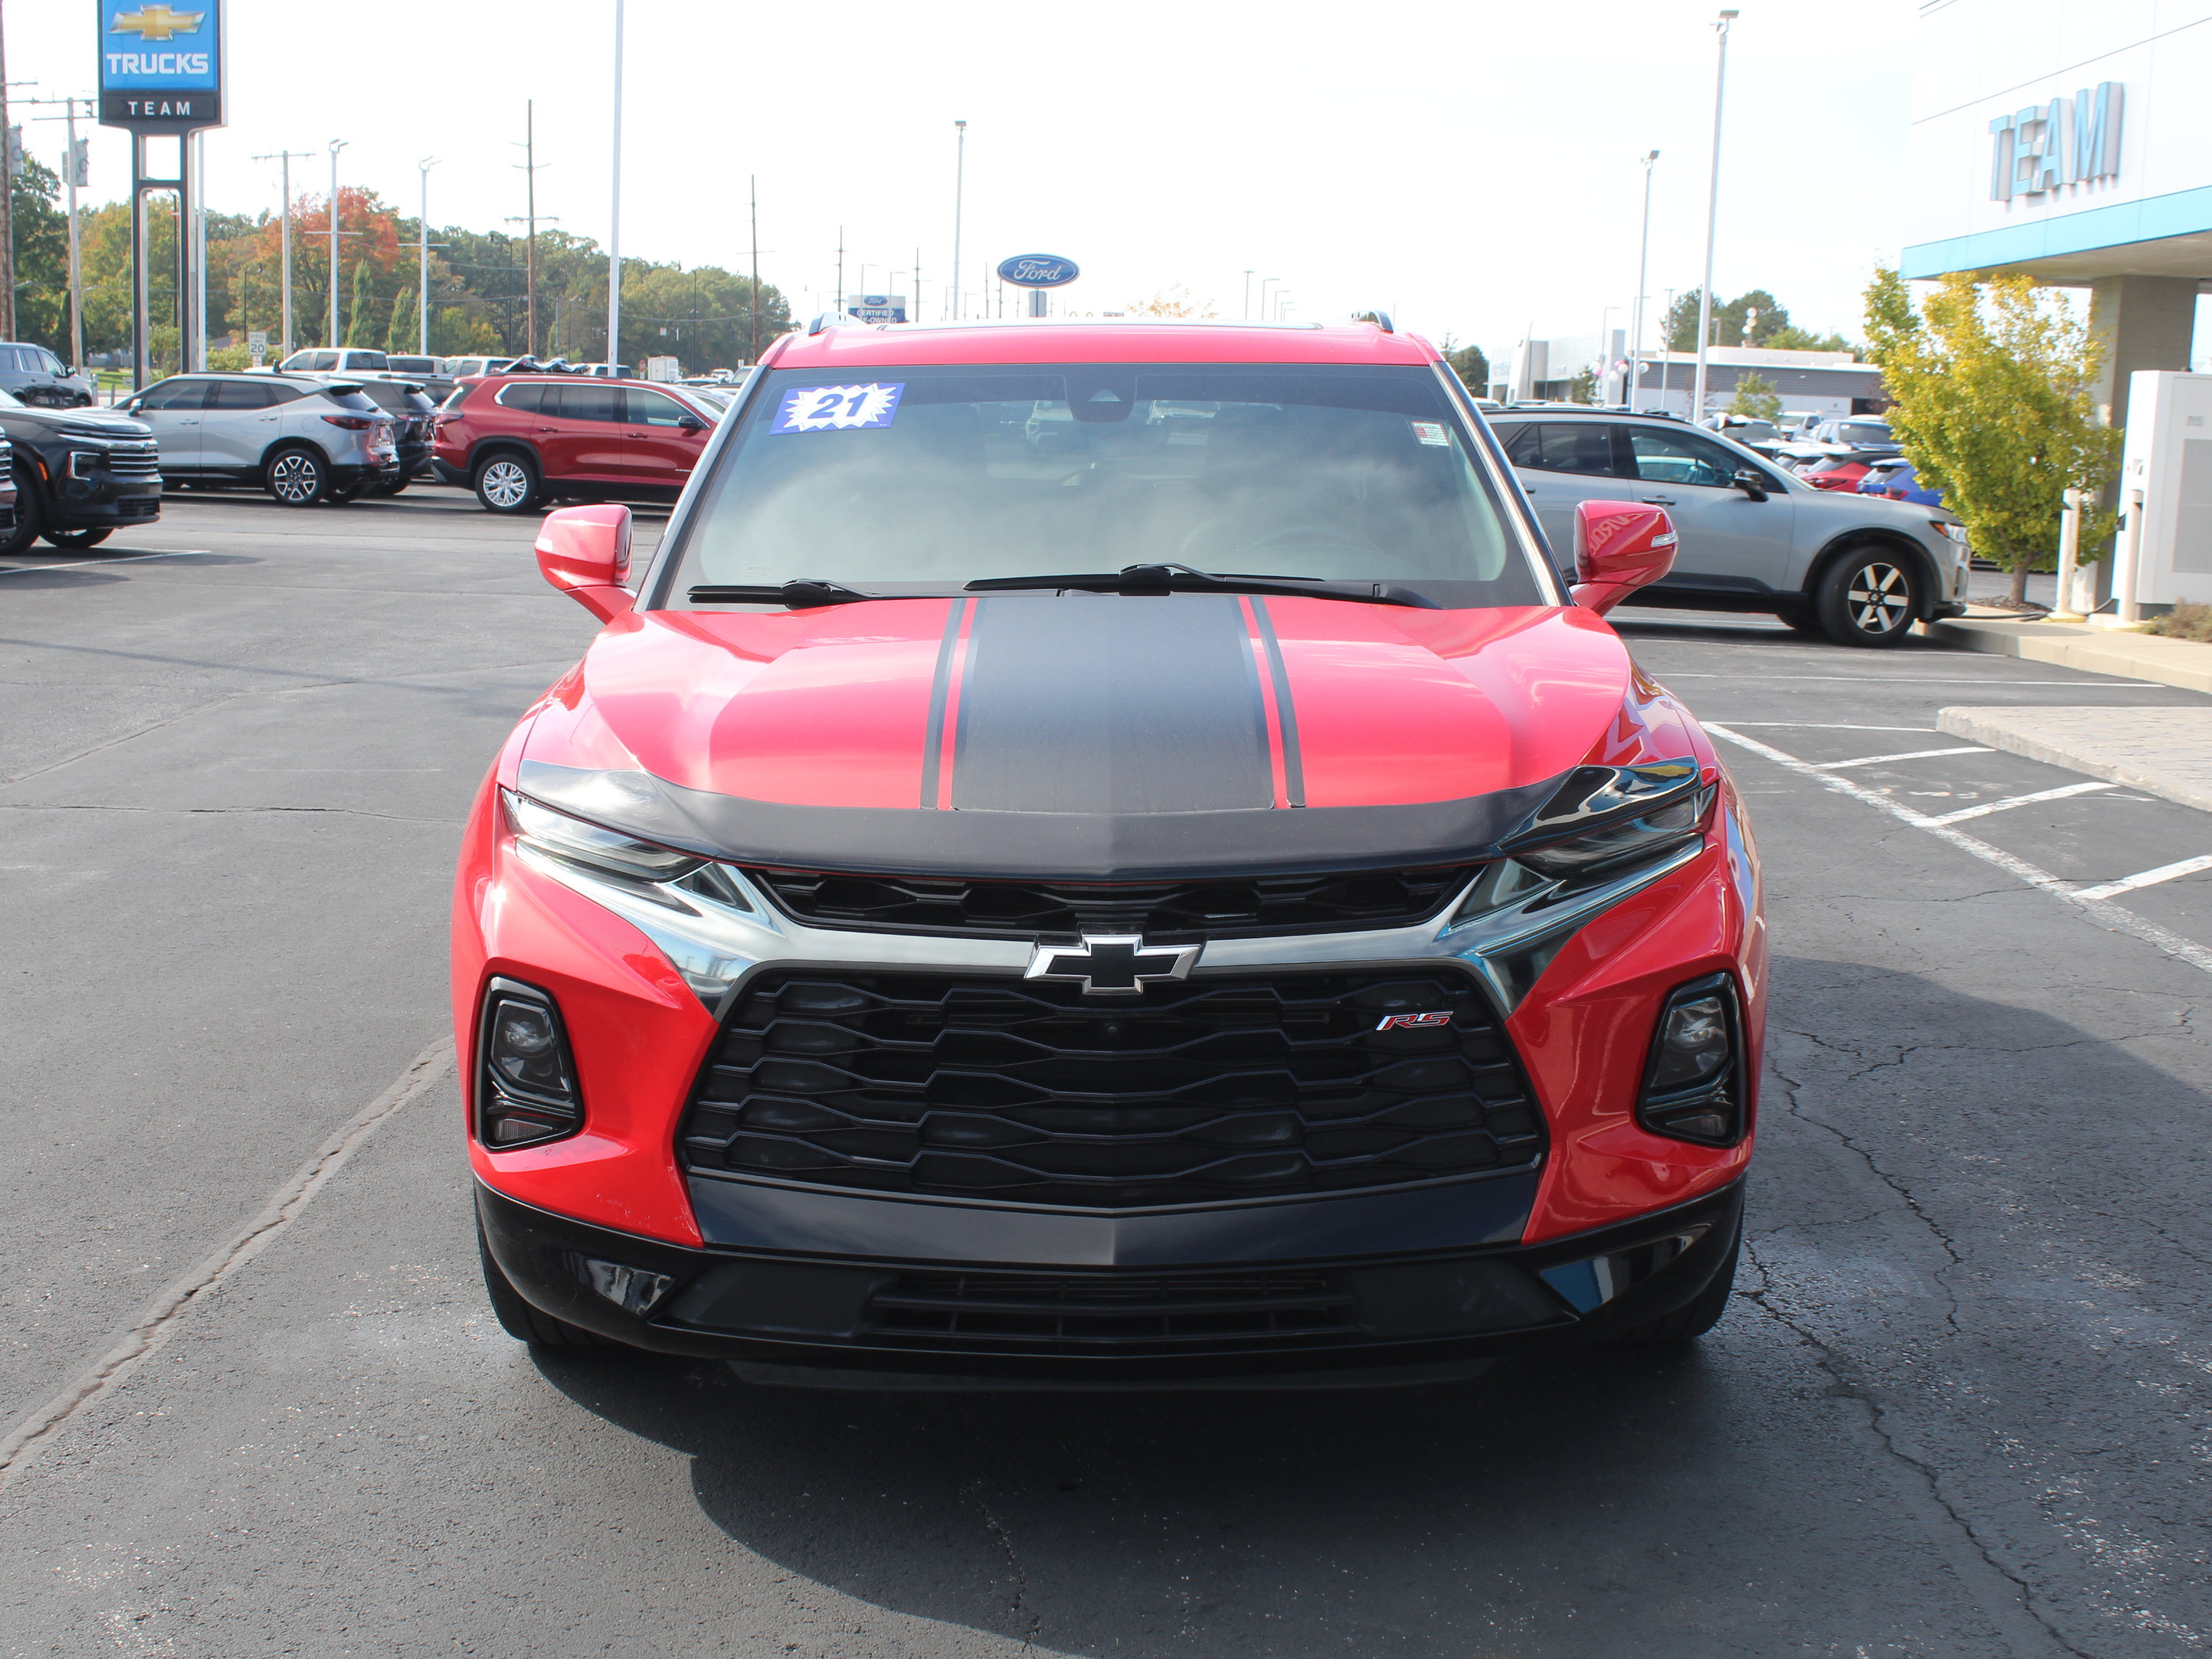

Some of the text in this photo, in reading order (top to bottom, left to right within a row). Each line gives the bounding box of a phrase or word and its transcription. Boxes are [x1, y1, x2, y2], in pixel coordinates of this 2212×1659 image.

[107, 53, 209, 75] TRUCKS
[128, 102, 192, 116] TEAM
[1988, 81, 2125, 202] TEAM
[1014, 259, 1062, 280] Ford
[251, 343, 265, 353] 20
[807, 392, 868, 420] 21
[1376, 1011, 1454, 1031] RS
